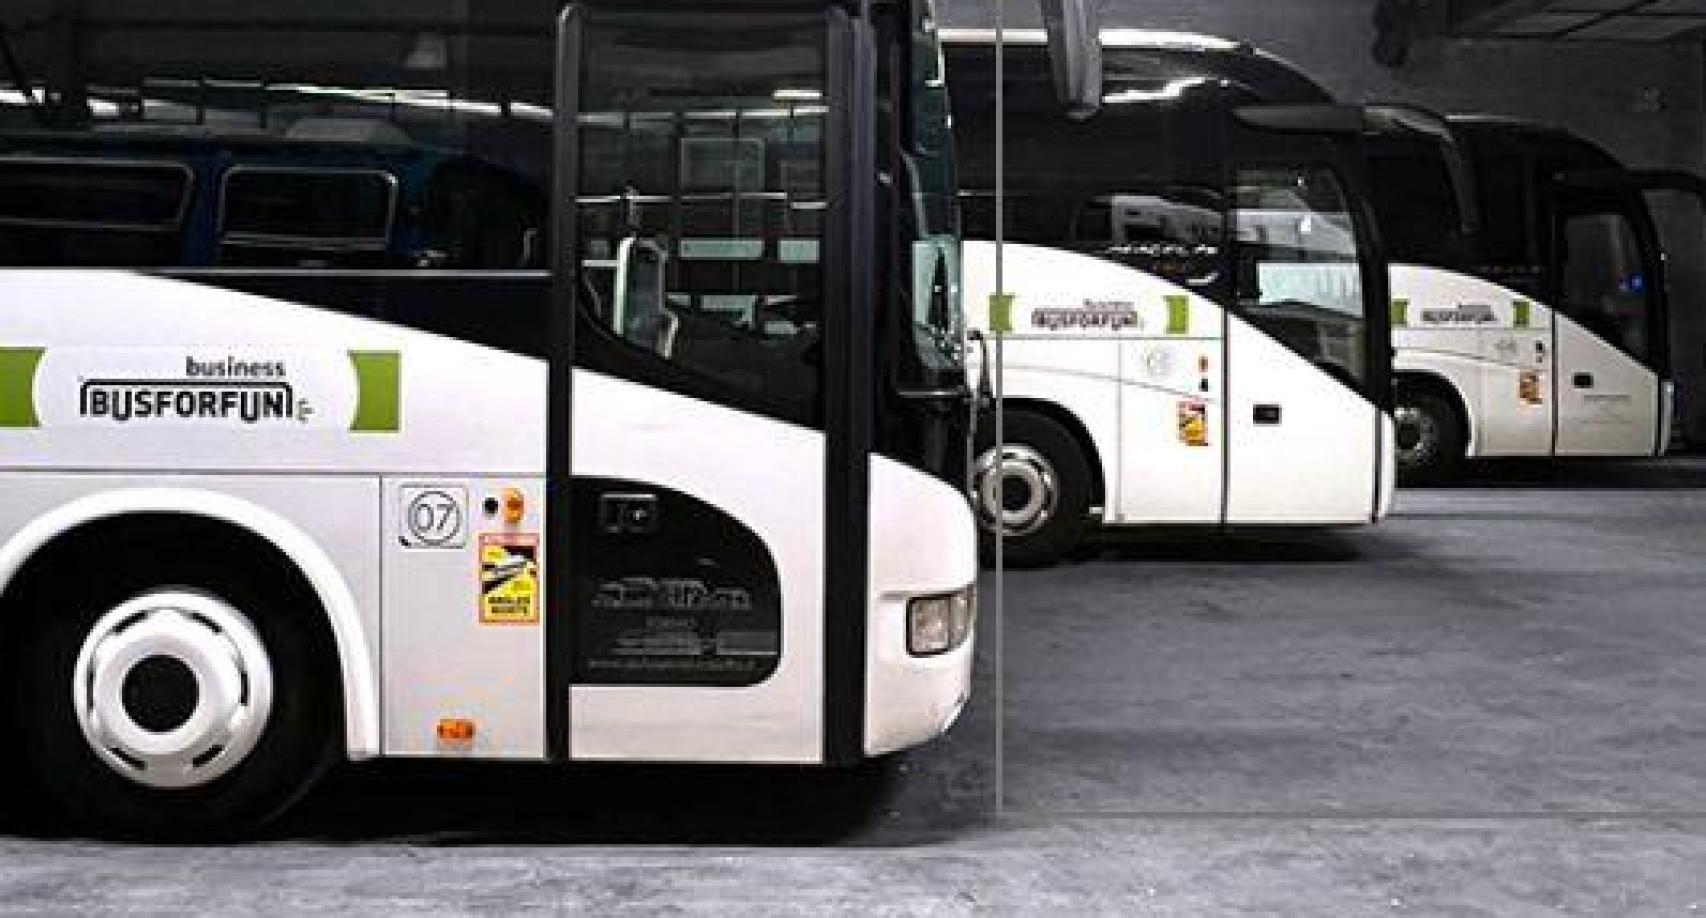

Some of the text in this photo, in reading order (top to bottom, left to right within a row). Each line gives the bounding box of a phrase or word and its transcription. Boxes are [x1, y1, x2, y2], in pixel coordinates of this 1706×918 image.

[185, 356, 286, 377] business
[86, 385, 287, 424] BUSFORFUN
[416, 502, 456, 532] 07
